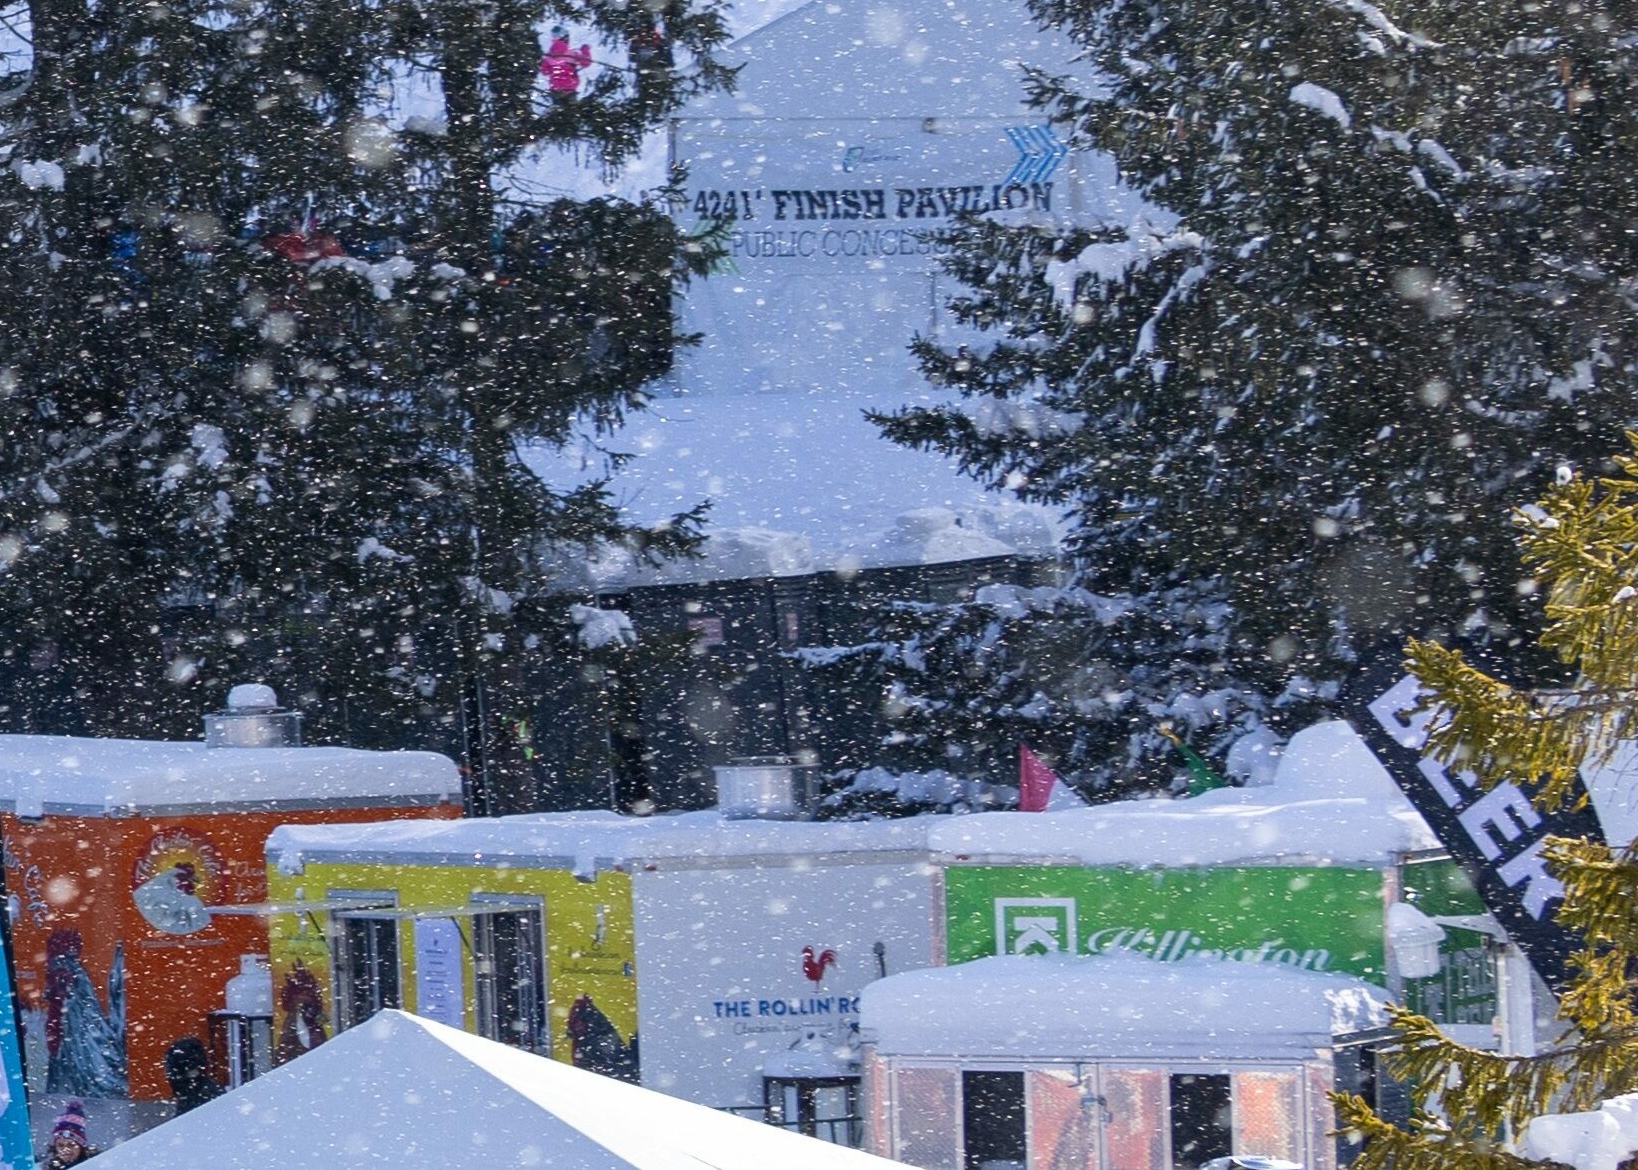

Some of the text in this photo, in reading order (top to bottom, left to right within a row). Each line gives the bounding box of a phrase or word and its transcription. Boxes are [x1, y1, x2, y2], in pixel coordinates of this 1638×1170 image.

[771, 189, 886, 222] FINISH
[894, 181, 1055, 219] PAVILION
[730, 232, 817, 259] PUBLIC
[713, 1000, 752, 1018] THE
[758, 996, 835, 1016] ROLLIN'
